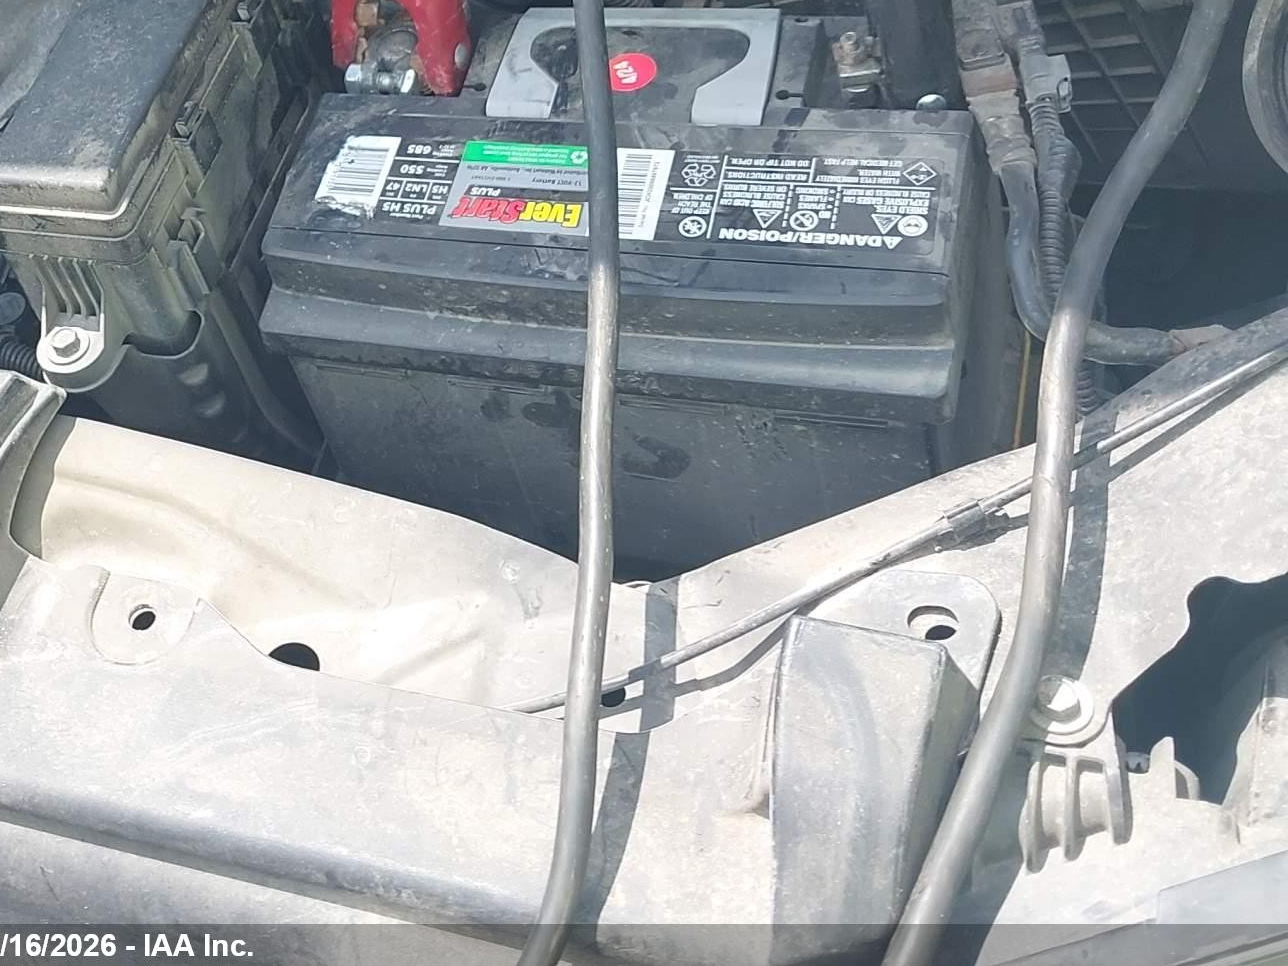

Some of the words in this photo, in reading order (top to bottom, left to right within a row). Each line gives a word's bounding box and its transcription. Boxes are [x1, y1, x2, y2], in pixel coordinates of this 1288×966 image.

[407, 144, 432, 154] 685
[400, 164, 425, 175] 550
[725, 171, 784, 180] INSTRUCTIONS.
[531, 177, 556, 185] Battery
[385, 182, 400, 190] 47
[405, 183, 427, 193] LN2
[432, 185, 448, 194] H5
[469, 186, 501, 196] PLUS
[382, 202, 401, 211] H5
[752, 201, 785, 209] SULFURIC
[884, 198, 929, 206] EXPLOSIVE
[402, 204, 437, 215] PLUS
[450, 195, 583, 228] EverStart
[899, 206, 928, 214] SHIELD
[718, 227, 884, 247] DANGER/POISON
